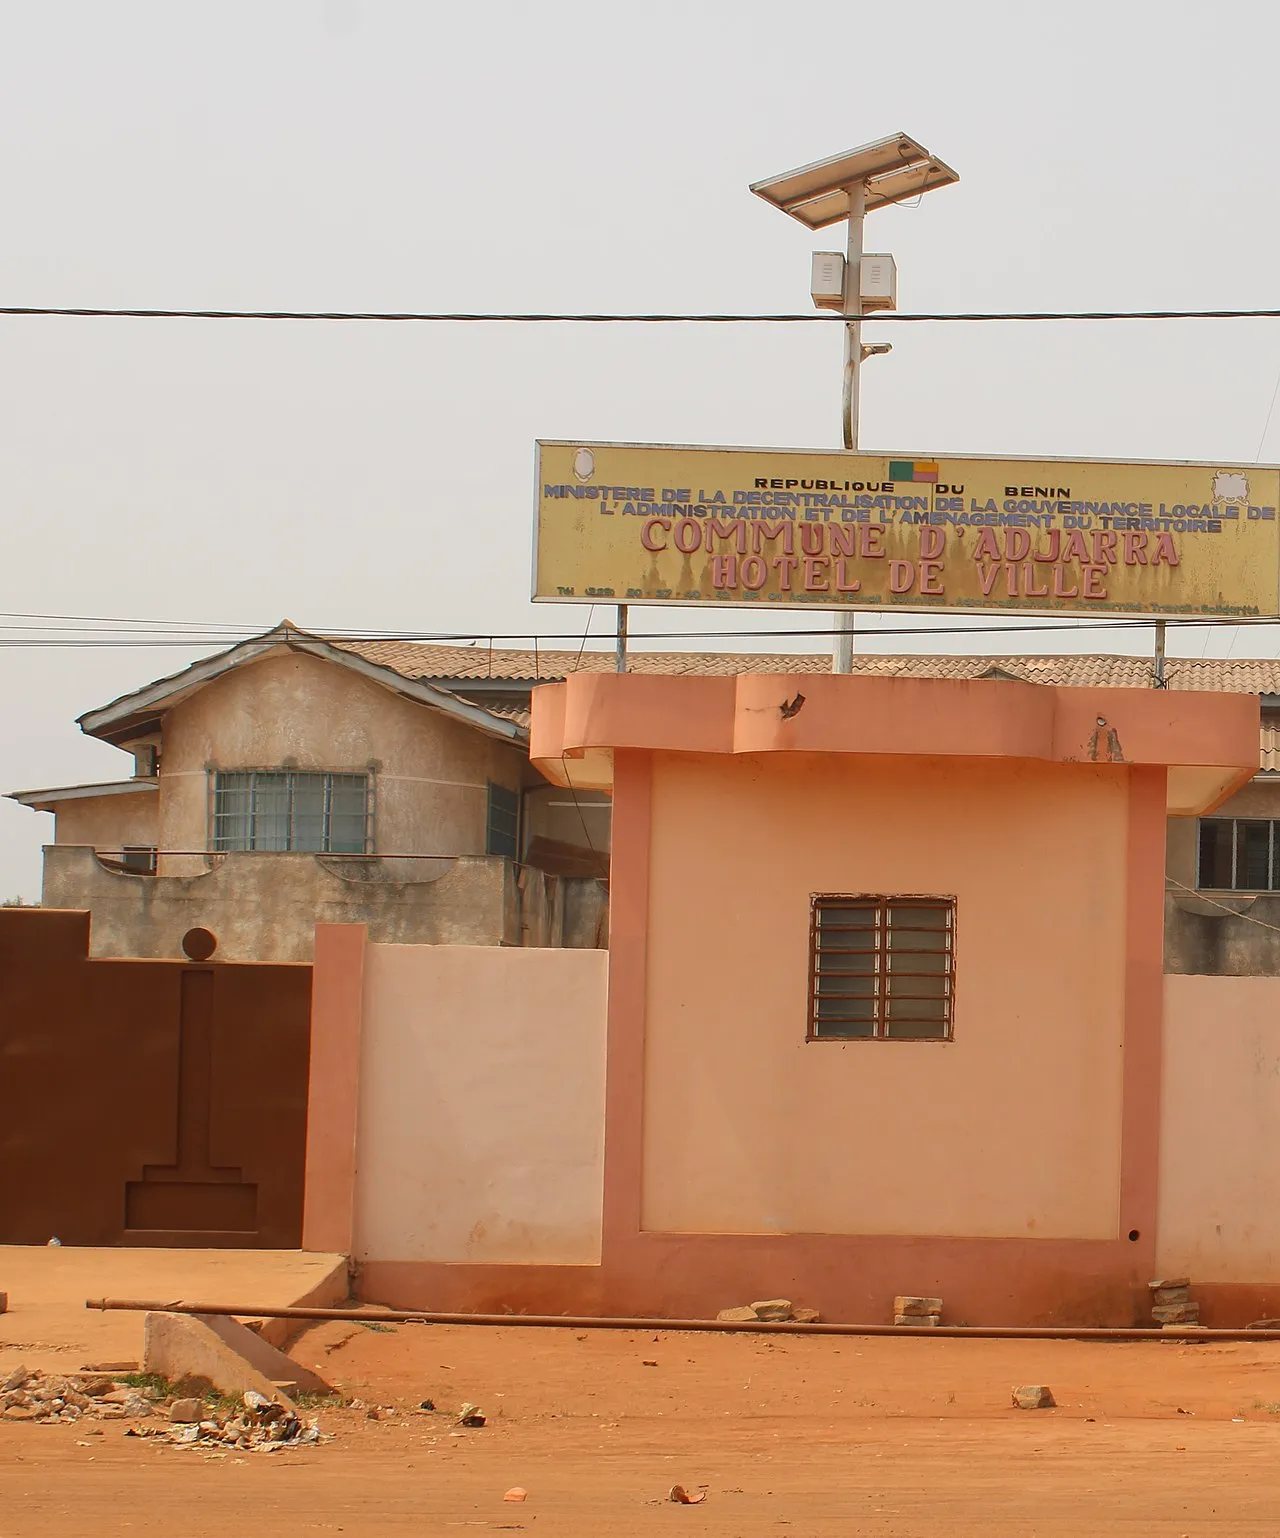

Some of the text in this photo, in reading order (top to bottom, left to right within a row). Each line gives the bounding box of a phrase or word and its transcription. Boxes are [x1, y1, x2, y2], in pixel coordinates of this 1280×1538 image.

[543, 484, 1276, 521] MINISTERE DE LA DECENTRALISATION DE LA GOUVERNANCE LOCALE DE
[754, 478, 1071, 499] REPUBLIQUE DU BENIN
[804, 508, 834, 522] ET
[841, 508, 871, 523] DE
[1063, 515, 1093, 530] DU
[1099, 516, 1222, 533] TERRITOIRE
[640, 517, 1180, 567] COMMUNE D'ADJARRA
[710, 554, 1109, 600] HOTEL DE VILLE
